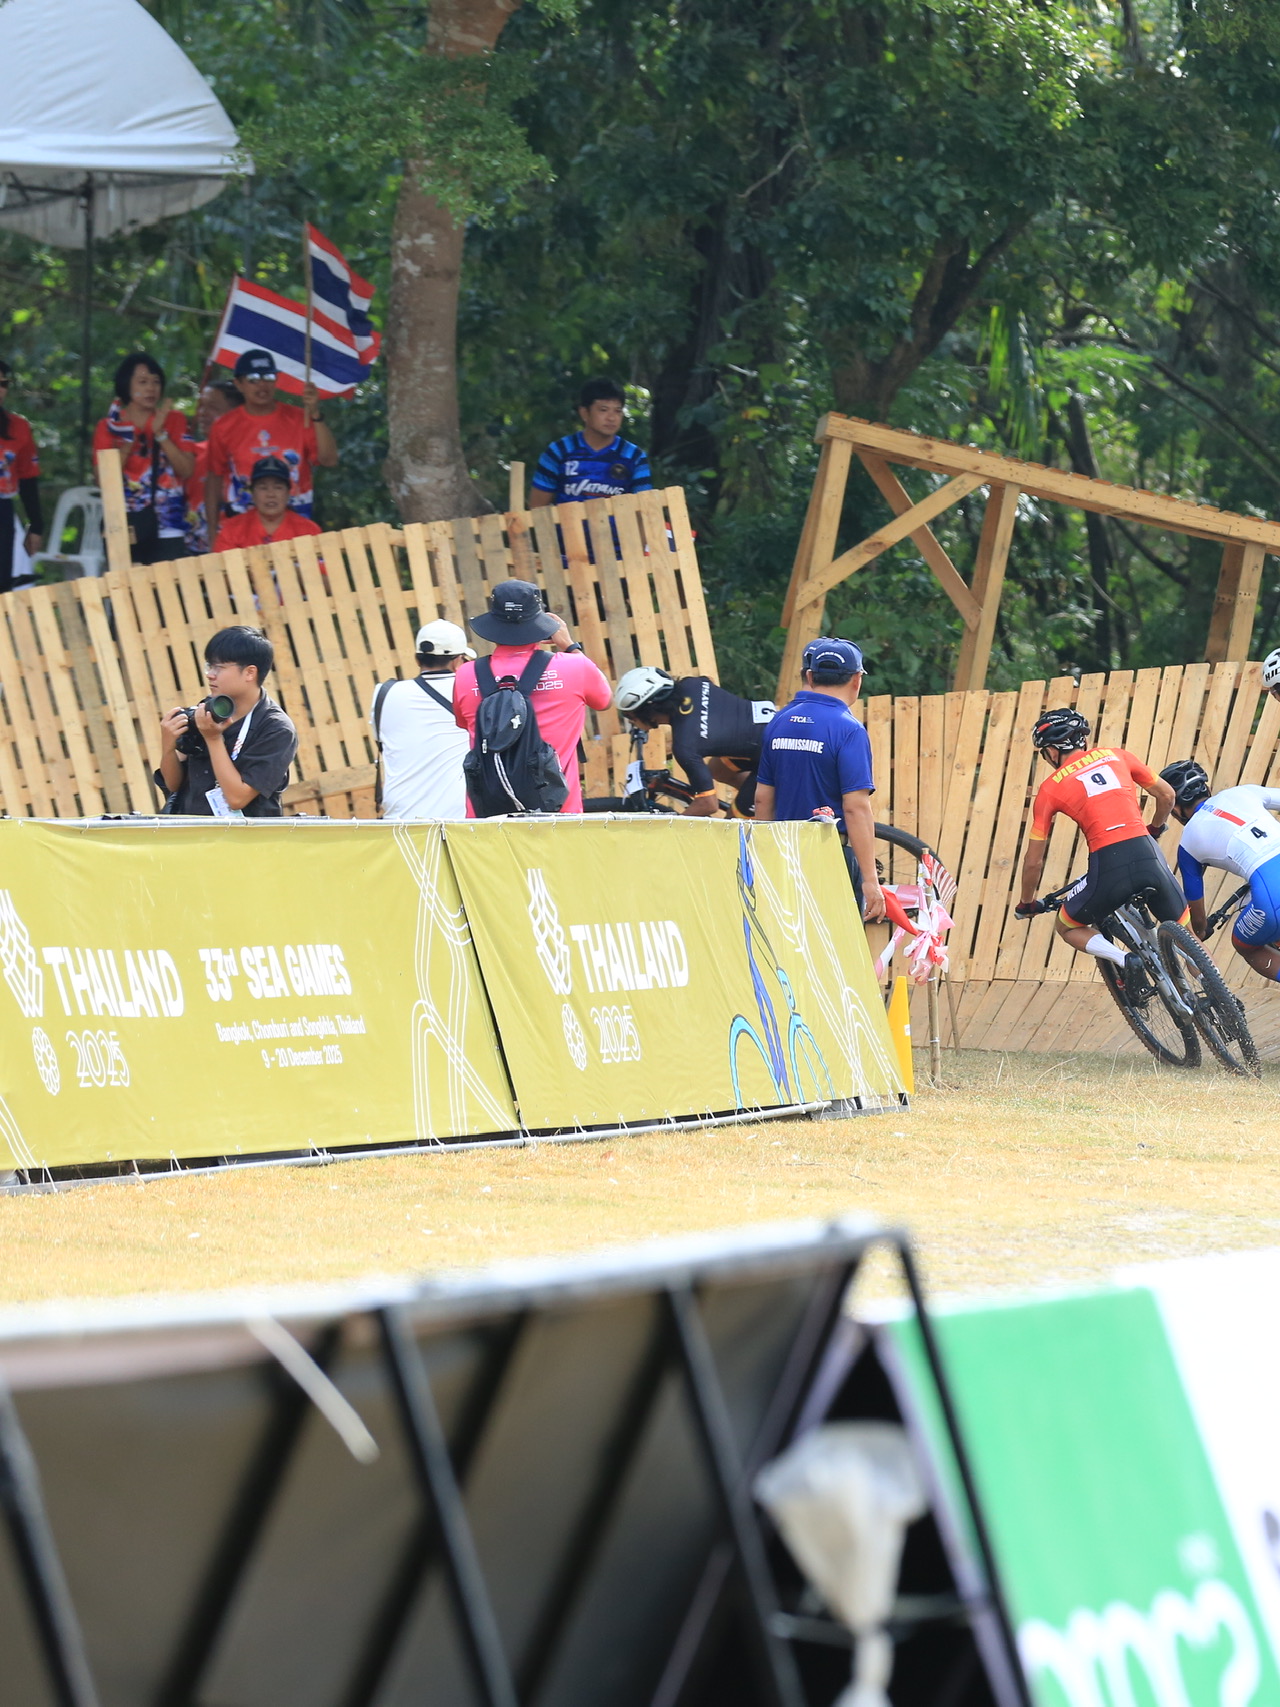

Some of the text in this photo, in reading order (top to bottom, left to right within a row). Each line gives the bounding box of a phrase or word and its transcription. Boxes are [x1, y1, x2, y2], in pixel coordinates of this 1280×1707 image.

[565, 460, 579, 476] 12
[533, 680, 563, 691] 025
[1264, 667, 1280, 682] HJC
[771, 737, 825, 754] COMMISSAIRE
[1052, 749, 1117, 784] VIETNAM
[1090, 772, 1107, 786] 9
[1250, 826, 1268, 839] 4
[569, 919, 690, 993] THAILAND
[41, 946, 185, 1018] THAILAND
[198, 944, 352, 1002] 33rd SEA GAMES
[215, 1022, 255, 1046] Bangkok,
[251, 1018, 290, 1040] Chonburi
[289, 1016, 304, 1037] and
[335, 1014, 367, 1035] Thailand
[590, 1005, 642, 1064] 2025
[65, 1029, 130, 1088] 2025
[261, 1048, 271, 1069] 9
[275, 1047, 290, 1068] 20
[286, 1046, 324, 1067] December
[322, 1044, 344, 1065] 2025
